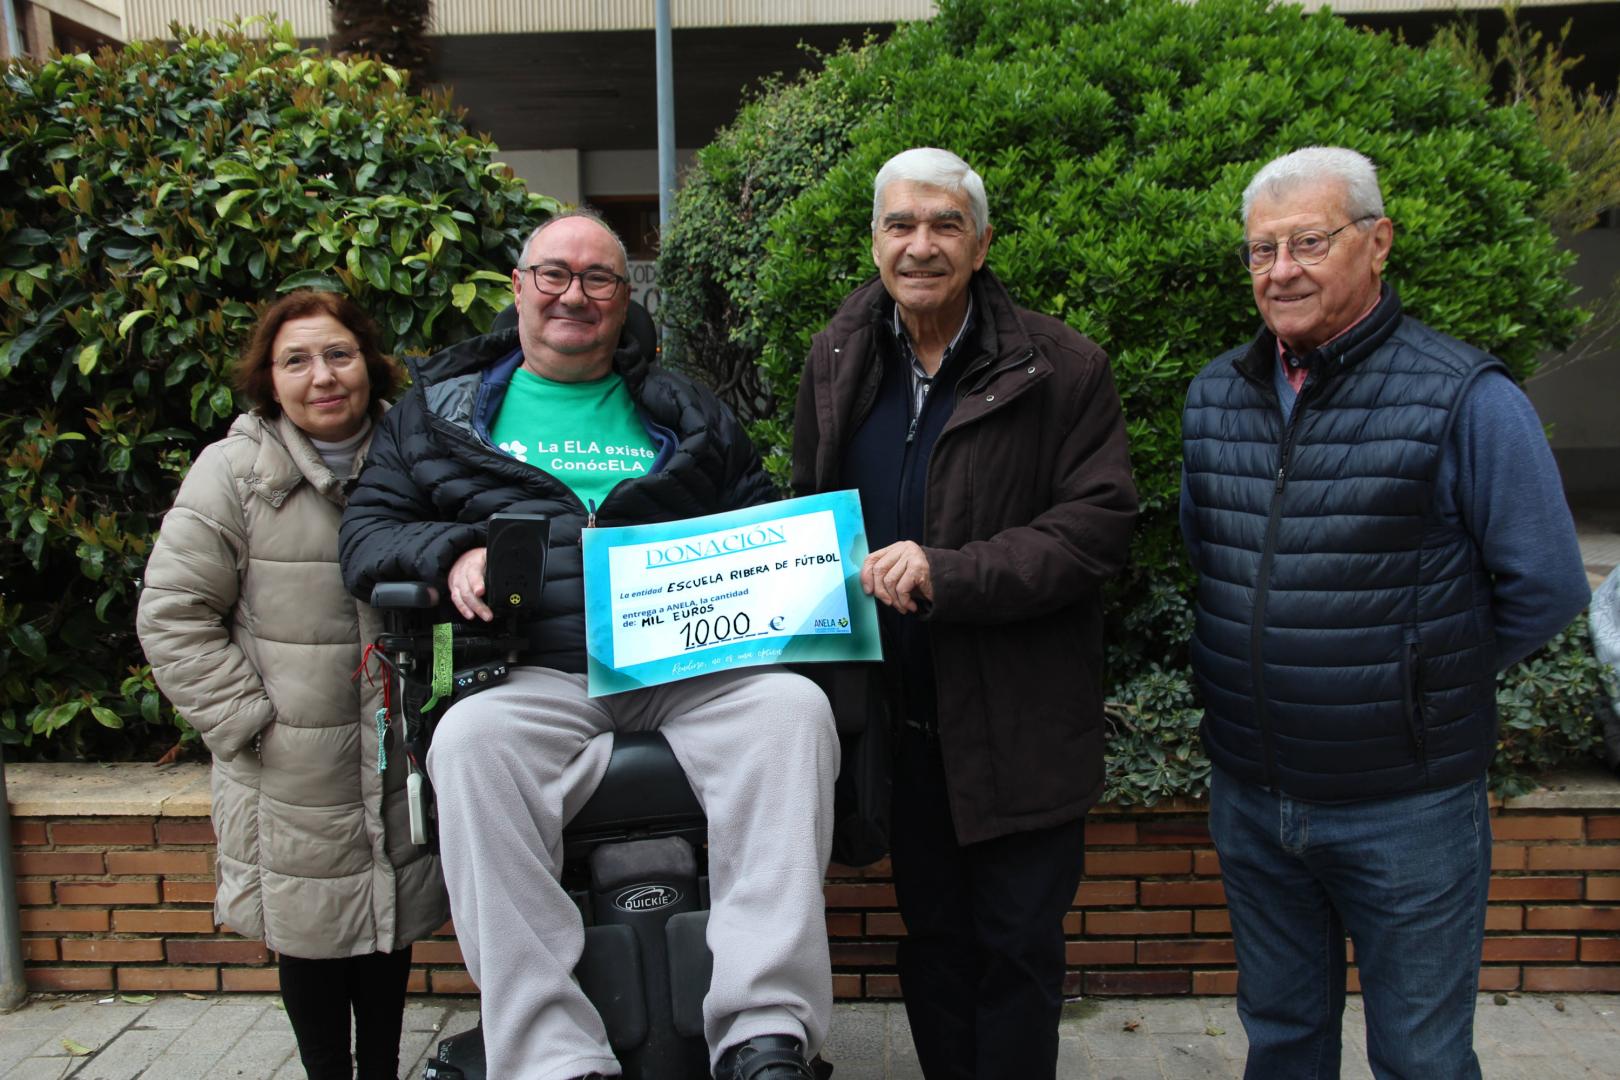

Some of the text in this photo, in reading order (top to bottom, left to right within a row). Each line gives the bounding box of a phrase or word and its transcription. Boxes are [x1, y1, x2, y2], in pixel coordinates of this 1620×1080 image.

[538, 441, 655, 459] La ELA existe
[551, 458, 645, 473] ConócELA
[645, 525, 786, 566] DONACIÓN
[631, 586, 663, 598] entidad
[667, 573, 723, 593] ESCUELA
[730, 565, 770, 580] RIBERA
[775, 560, 789, 570] DE
[795, 552, 840, 568] FÚTBOL
[622, 609, 657, 620] entrega
[667, 600, 698, 612] ANELA,
[710, 588, 749, 602] cantidad
[622, 604, 714, 628] de: MIL EUROS
[814, 618, 836, 628] ANELA
